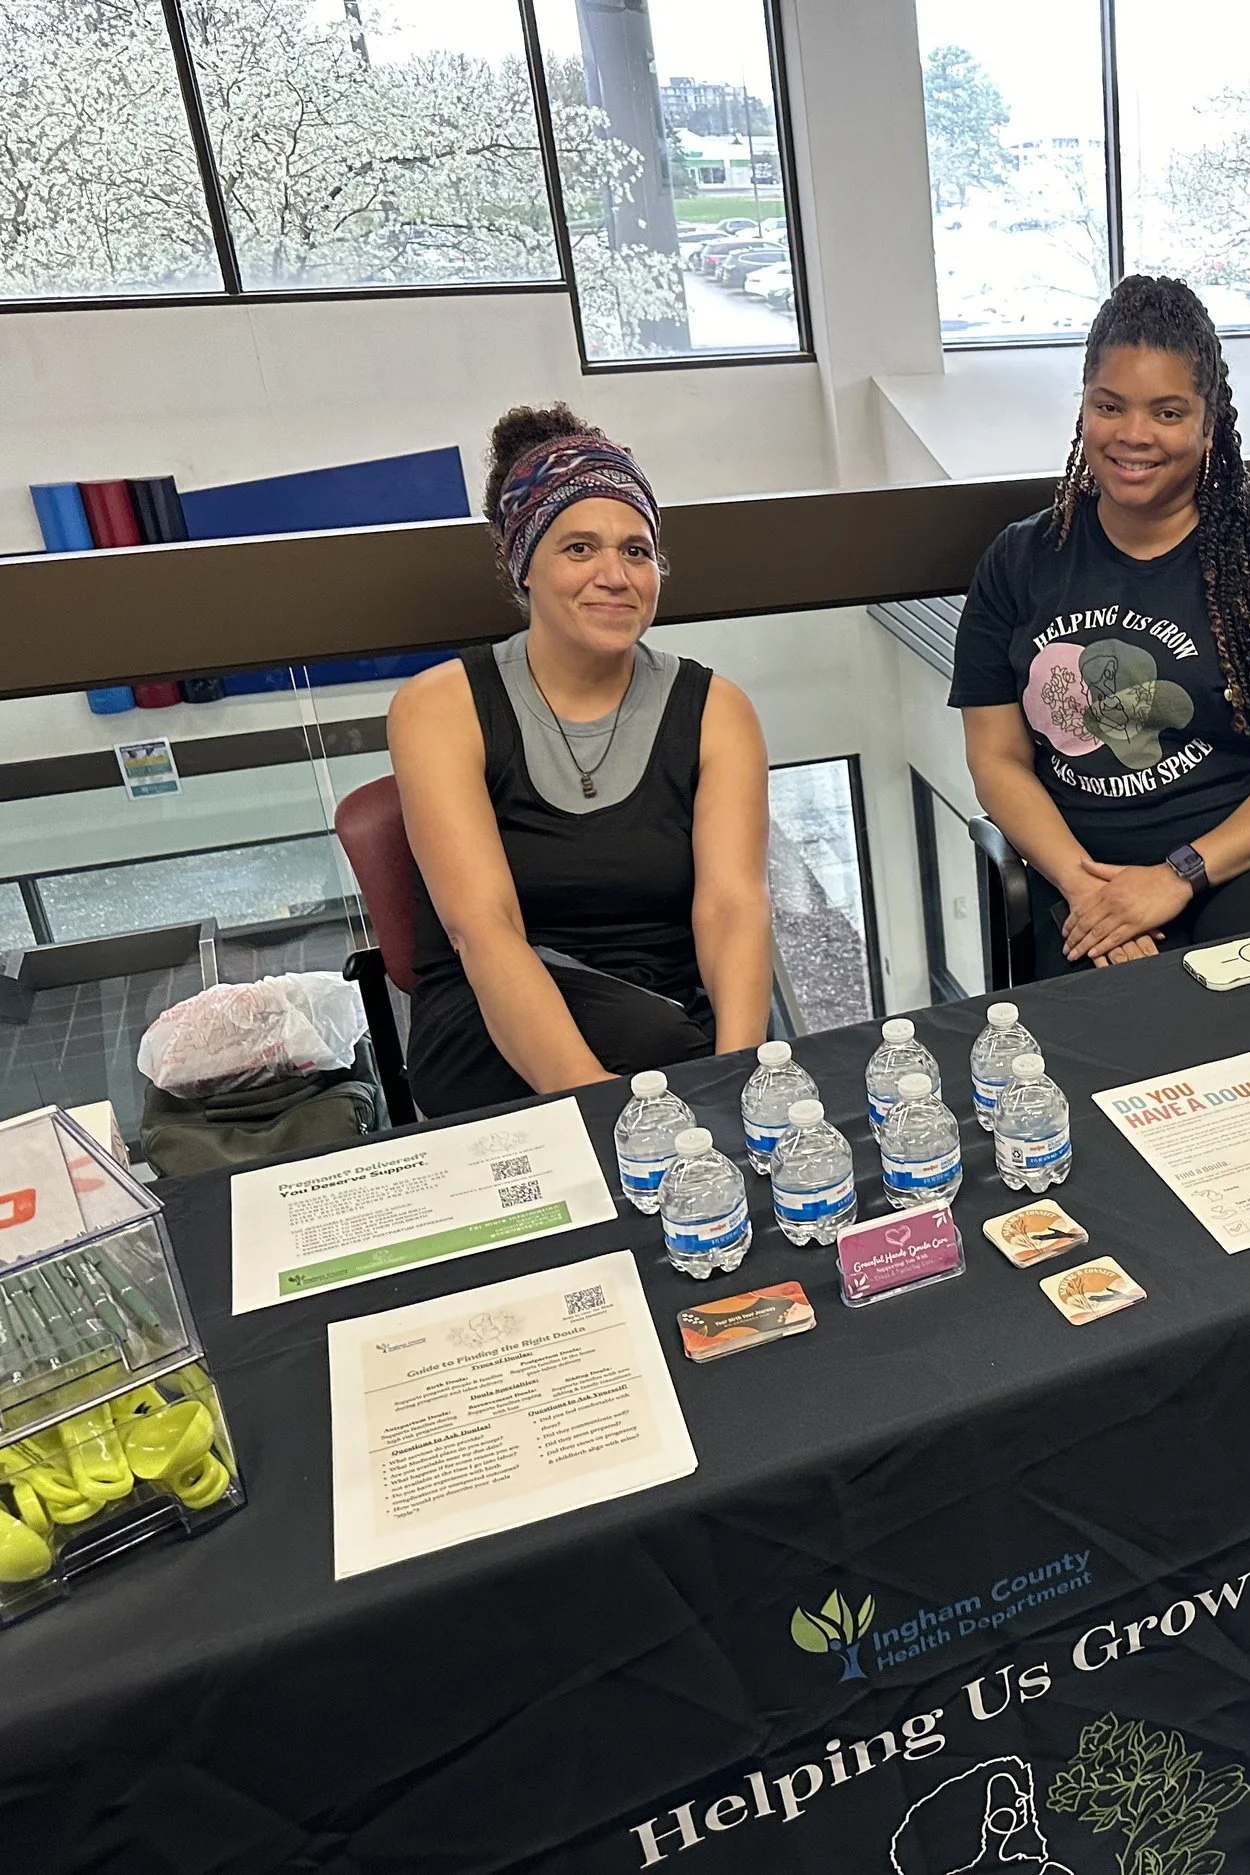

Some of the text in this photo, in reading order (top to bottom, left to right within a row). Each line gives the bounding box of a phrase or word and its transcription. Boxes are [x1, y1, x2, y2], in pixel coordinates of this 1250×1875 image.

[1033, 604, 1199, 661] HELPING US GROW
[1076, 768, 1158, 798] HOLDING
[1157, 738, 1214, 785] SPACE
[1112, 1082, 1195, 1115] DO YOU
[1124, 1102, 1188, 1129] HAVE
[1190, 1098, 1208, 1113] A
[278, 1150, 427, 1193] Pregnant? Delivered?
[279, 1158, 429, 1198] You Deserve Support.
[1173, 1169, 1196, 1180] Find
[1200, 1159, 1231, 1172] doula.
[852, 1252, 885, 1273] Graceful
[884, 1247, 907, 1264] Hands
[907, 1239, 931, 1258] Doula
[931, 1234, 948, 1248] Care
[754, 1306, 776, 1315] Journey
[406, 1325, 585, 1377] Guide to Finding the Right Doula
[872, 1549, 1090, 1650] Ingham County
[876, 1571, 1093, 1672] Health Department
[628, 1707, 948, 1869] Helping
[961, 1662, 1054, 1722] Us
